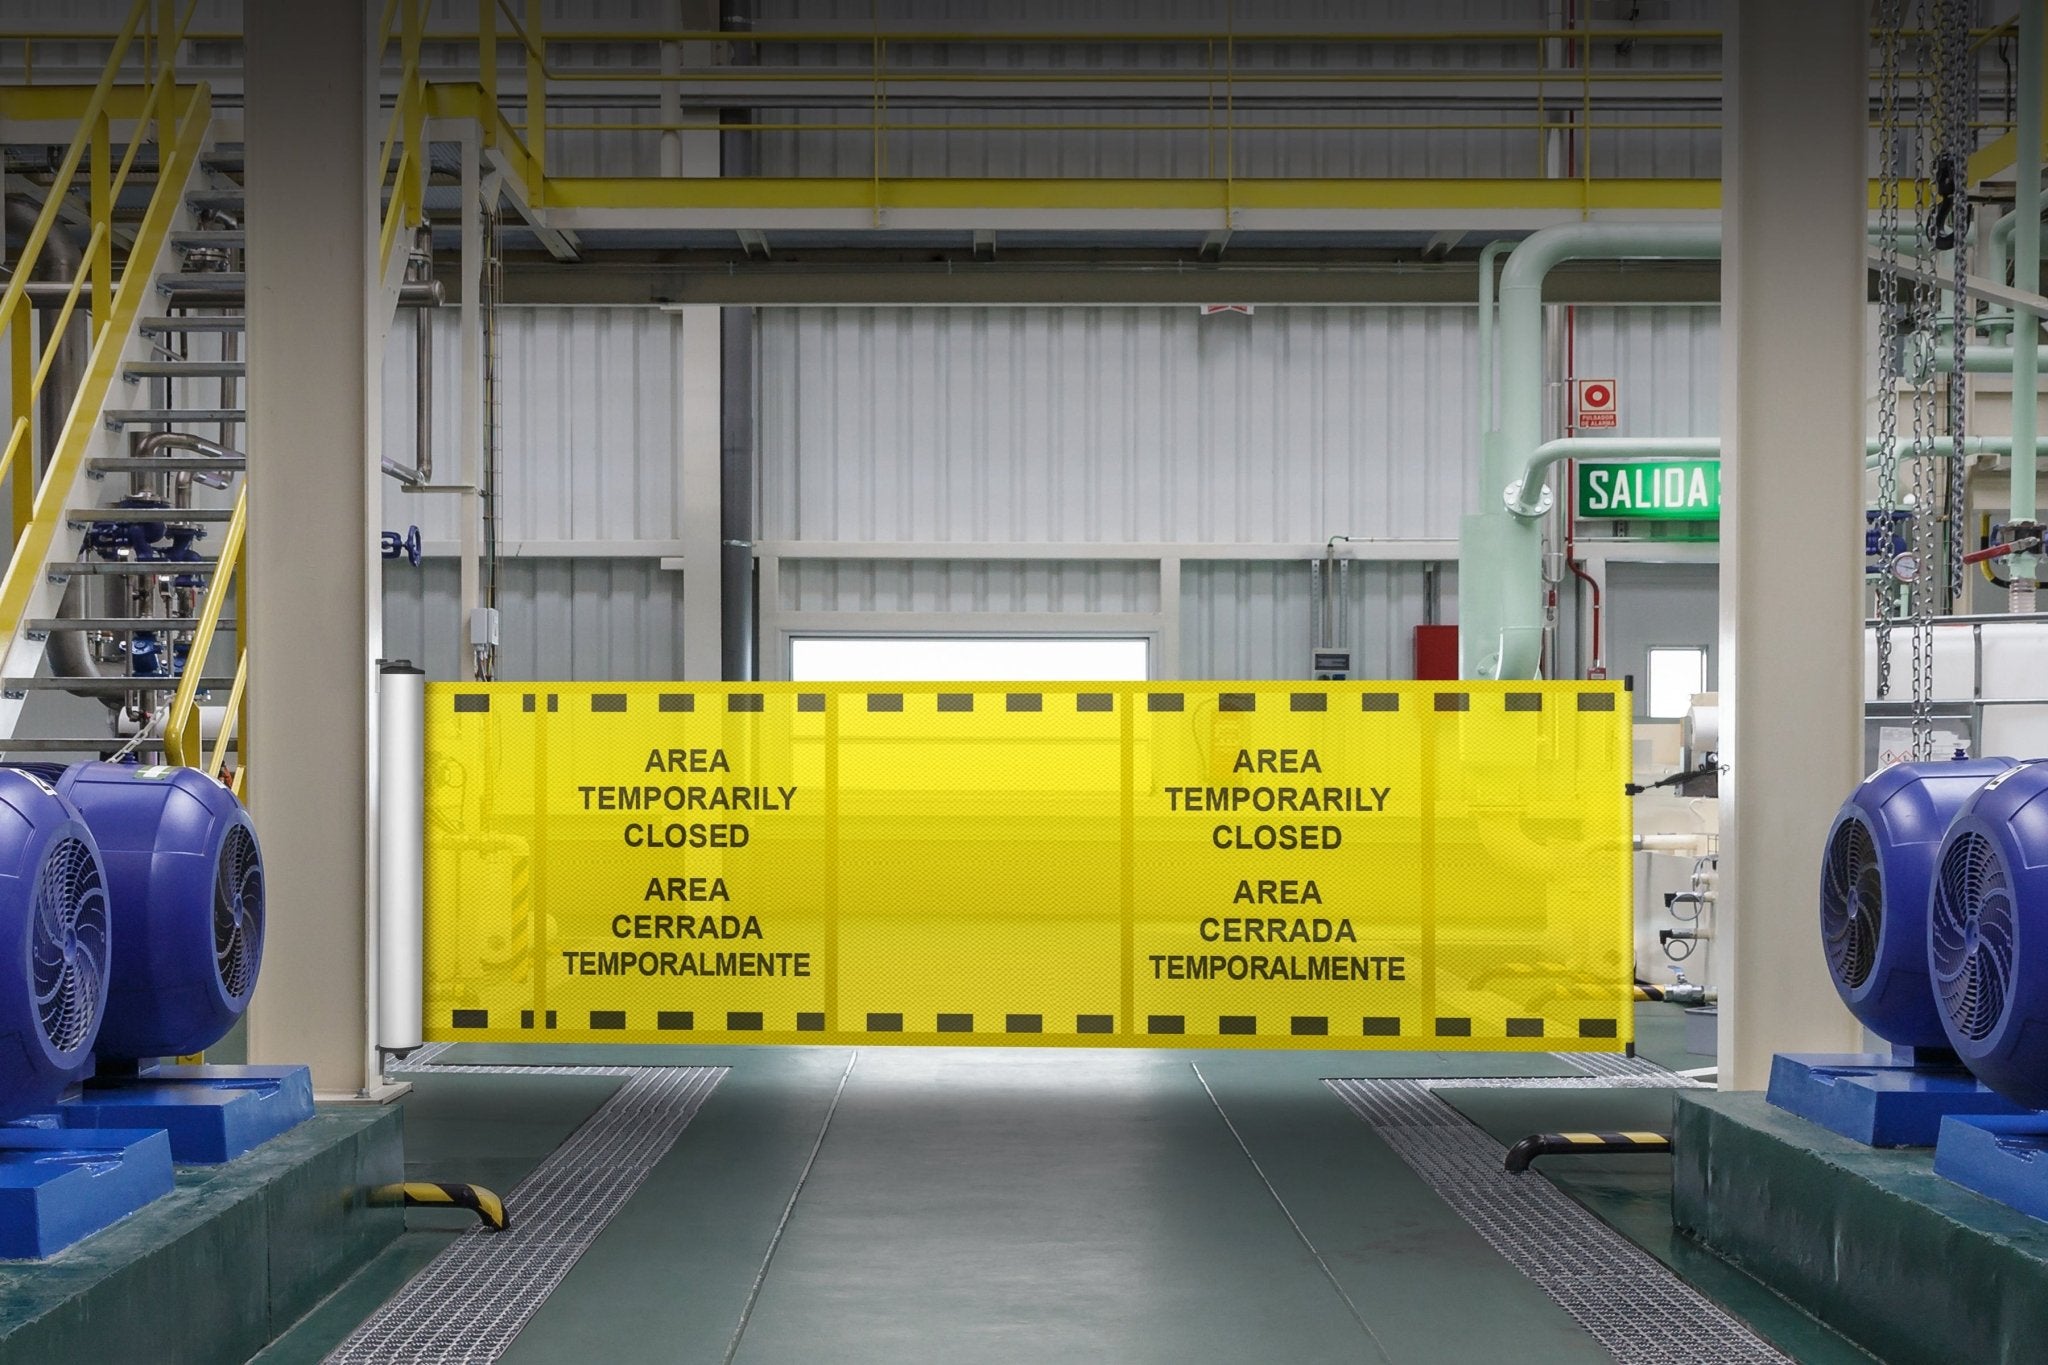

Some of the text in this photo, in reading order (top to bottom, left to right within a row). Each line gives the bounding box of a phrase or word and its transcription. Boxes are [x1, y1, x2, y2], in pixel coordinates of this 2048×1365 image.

[1589, 467, 1708, 509] SALIDA
[646, 749, 729, 771] AREA
[1233, 749, 1321, 773] AREA
[578, 786, 796, 809] TEMPORARILY
[1165, 787, 1389, 812] TEMPORARILY
[624, 824, 748, 848] CLOSED
[1212, 825, 1342, 850] CLOSED
[645, 878, 729, 901] AREA
[1233, 880, 1321, 904] AREA
[612, 915, 762, 939] CERRADA
[1200, 917, 1357, 943] CERRADA
[562, 952, 811, 976] TEMPORALMENTE
[1148, 955, 1406, 981] TEMPORALMENTE
